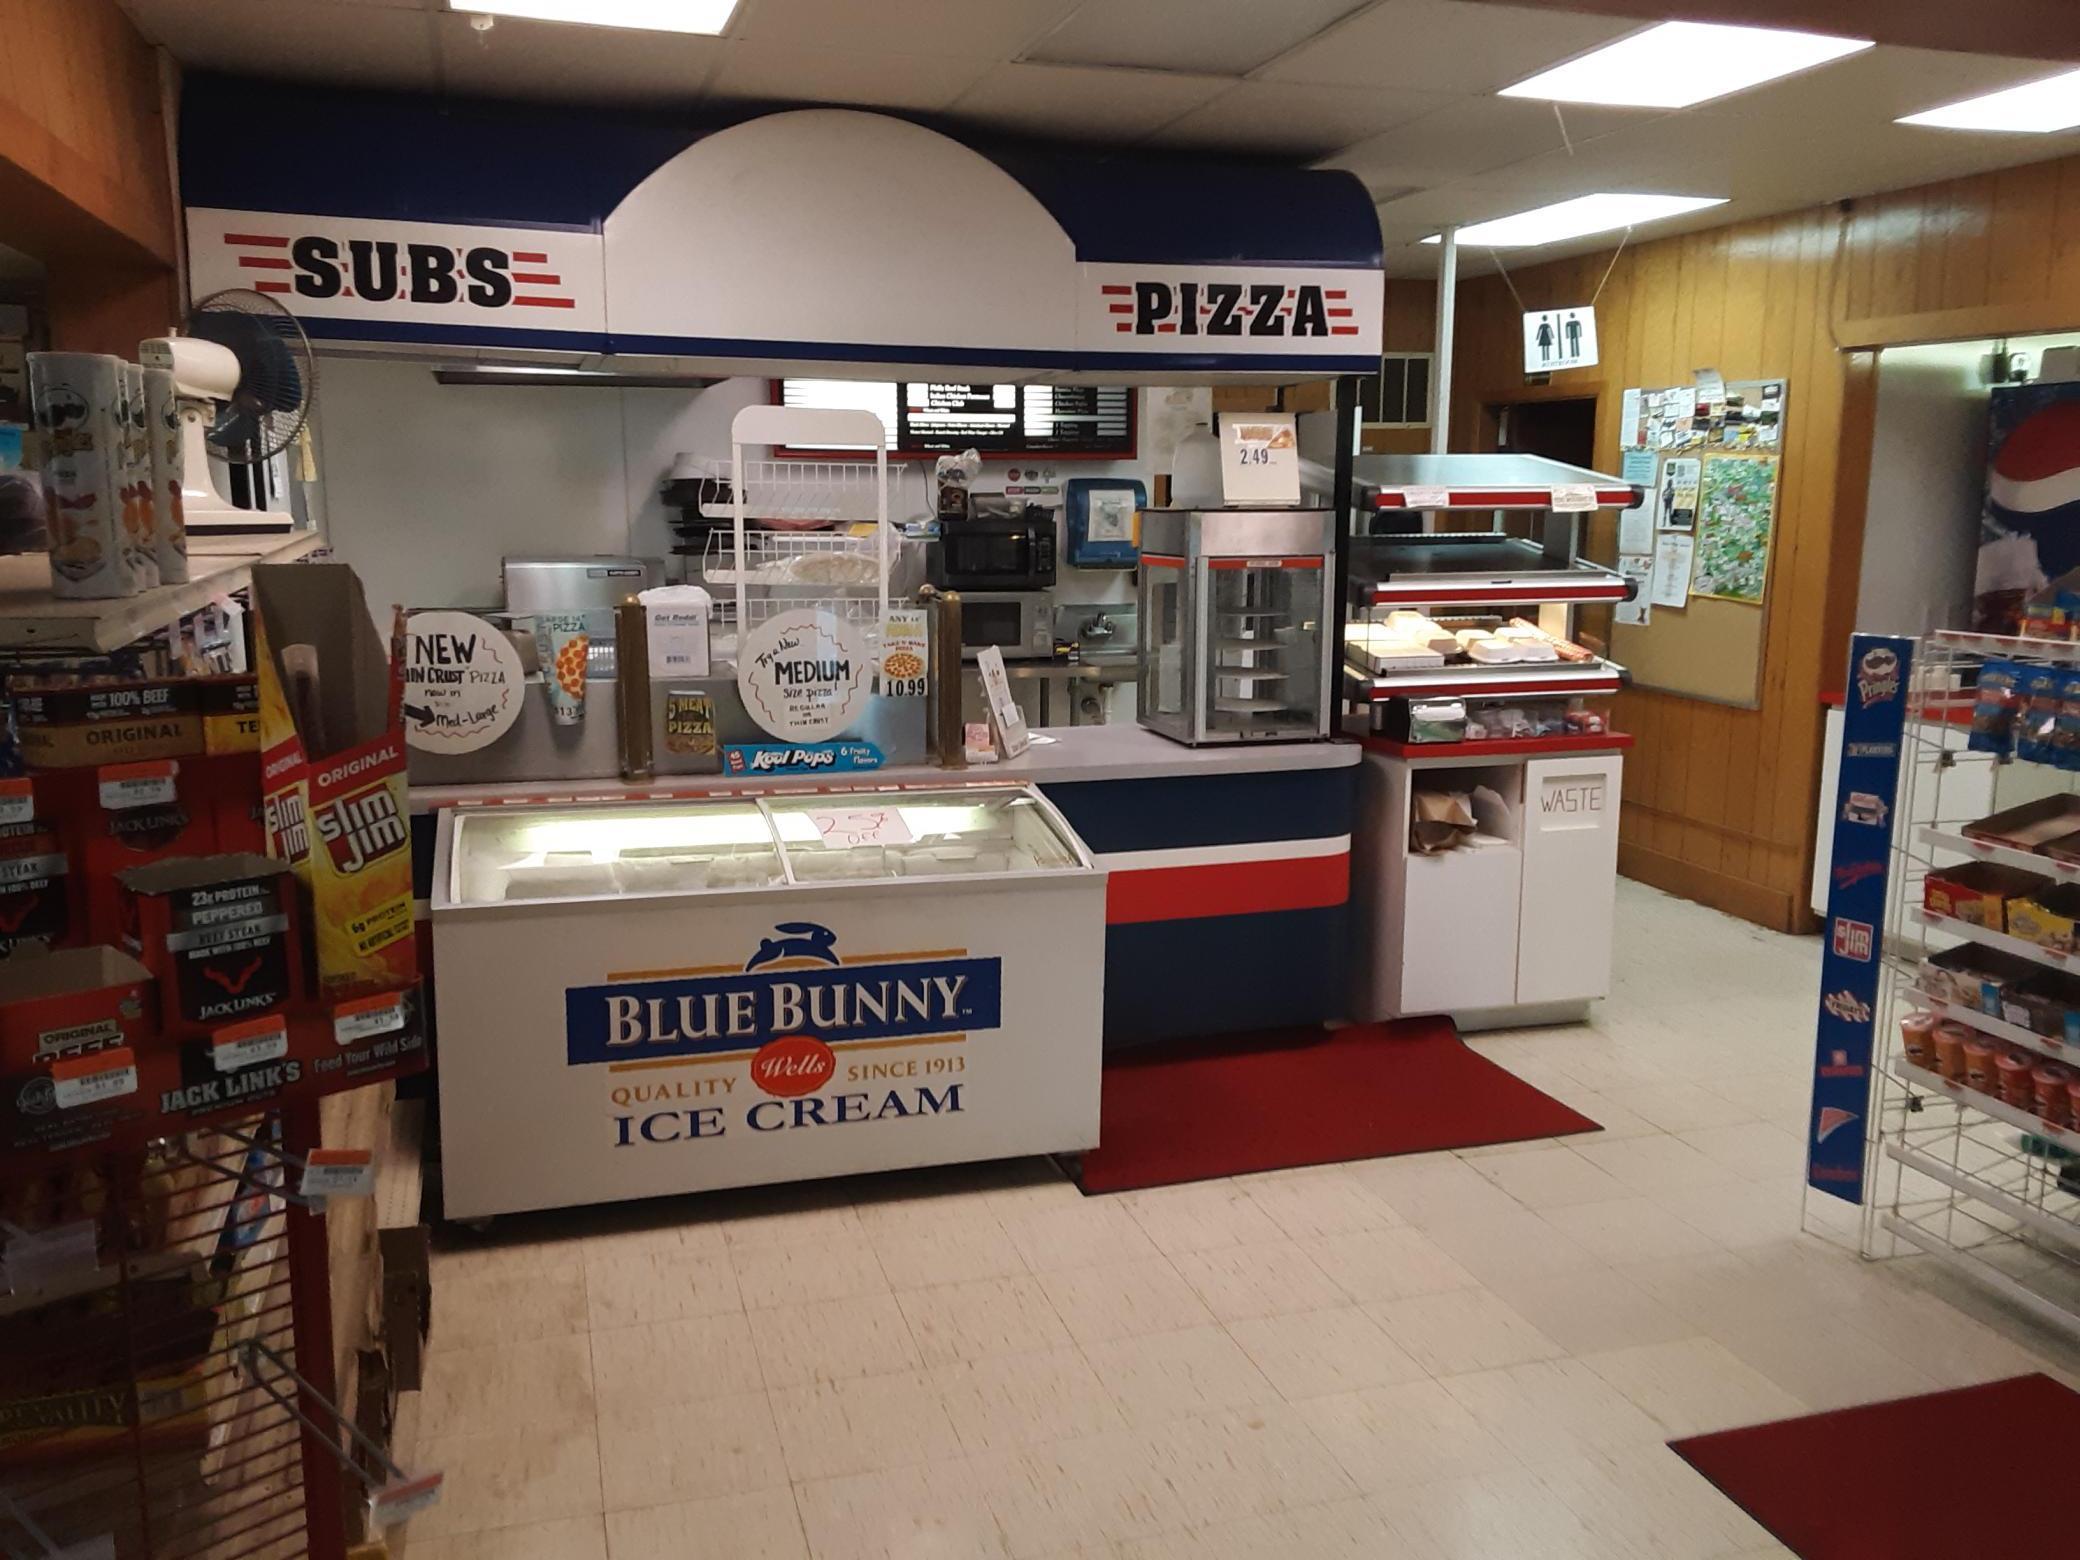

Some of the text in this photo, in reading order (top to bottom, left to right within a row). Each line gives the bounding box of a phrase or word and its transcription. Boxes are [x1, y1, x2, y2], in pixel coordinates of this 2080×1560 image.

[291, 236, 513, 308] SUBS
[1135, 282, 1329, 337] PIZZA
[1240, 449, 1269, 465] 2.49
[553, 623, 586, 633] PIZZA
[415, 634, 477, 665] NEW
[755, 637, 800, 669] Try a New
[427, 667, 466, 684] CRUST
[469, 671, 506, 684] PIZZA
[774, 659, 851, 686] MEDIUM
[109, 690, 141, 708] 100%
[143, 688, 169, 705] BEEF
[886, 677, 926, 697] 10.99
[679, 697, 711, 719] MEAT
[86, 723, 183, 746] ORIGINAL
[669, 721, 713, 734] PIZZA
[751, 750, 791, 770] Kool
[791, 749, 834, 767] Pops
[840, 747, 848, 756] 6
[266, 750, 303, 780] ORIGINAL
[317, 745, 400, 788] ORIGINAL
[1540, 786, 1603, 813] WASTE
[214, 884, 260, 902] PROTEIN
[191, 900, 263, 926] PEPPERED
[198, 1001, 235, 1021] JACK
[605, 973, 967, 1049] BLUE BUNNY
[43, 1023, 114, 1045] ORIGINAL
[313, 1053, 343, 1074] Feed
[344, 1049, 372, 1065] Your
[371, 1039, 399, 1056] Wild
[399, 1035, 422, 1051] Side
[760, 1051, 827, 1079] Wells
[160, 1080, 220, 1115] JACK
[223, 1060, 302, 1099] LINK'S
[609, 1056, 966, 1108] QUALITY SINCE 1913
[613, 1083, 966, 1149] ICE CREAM
